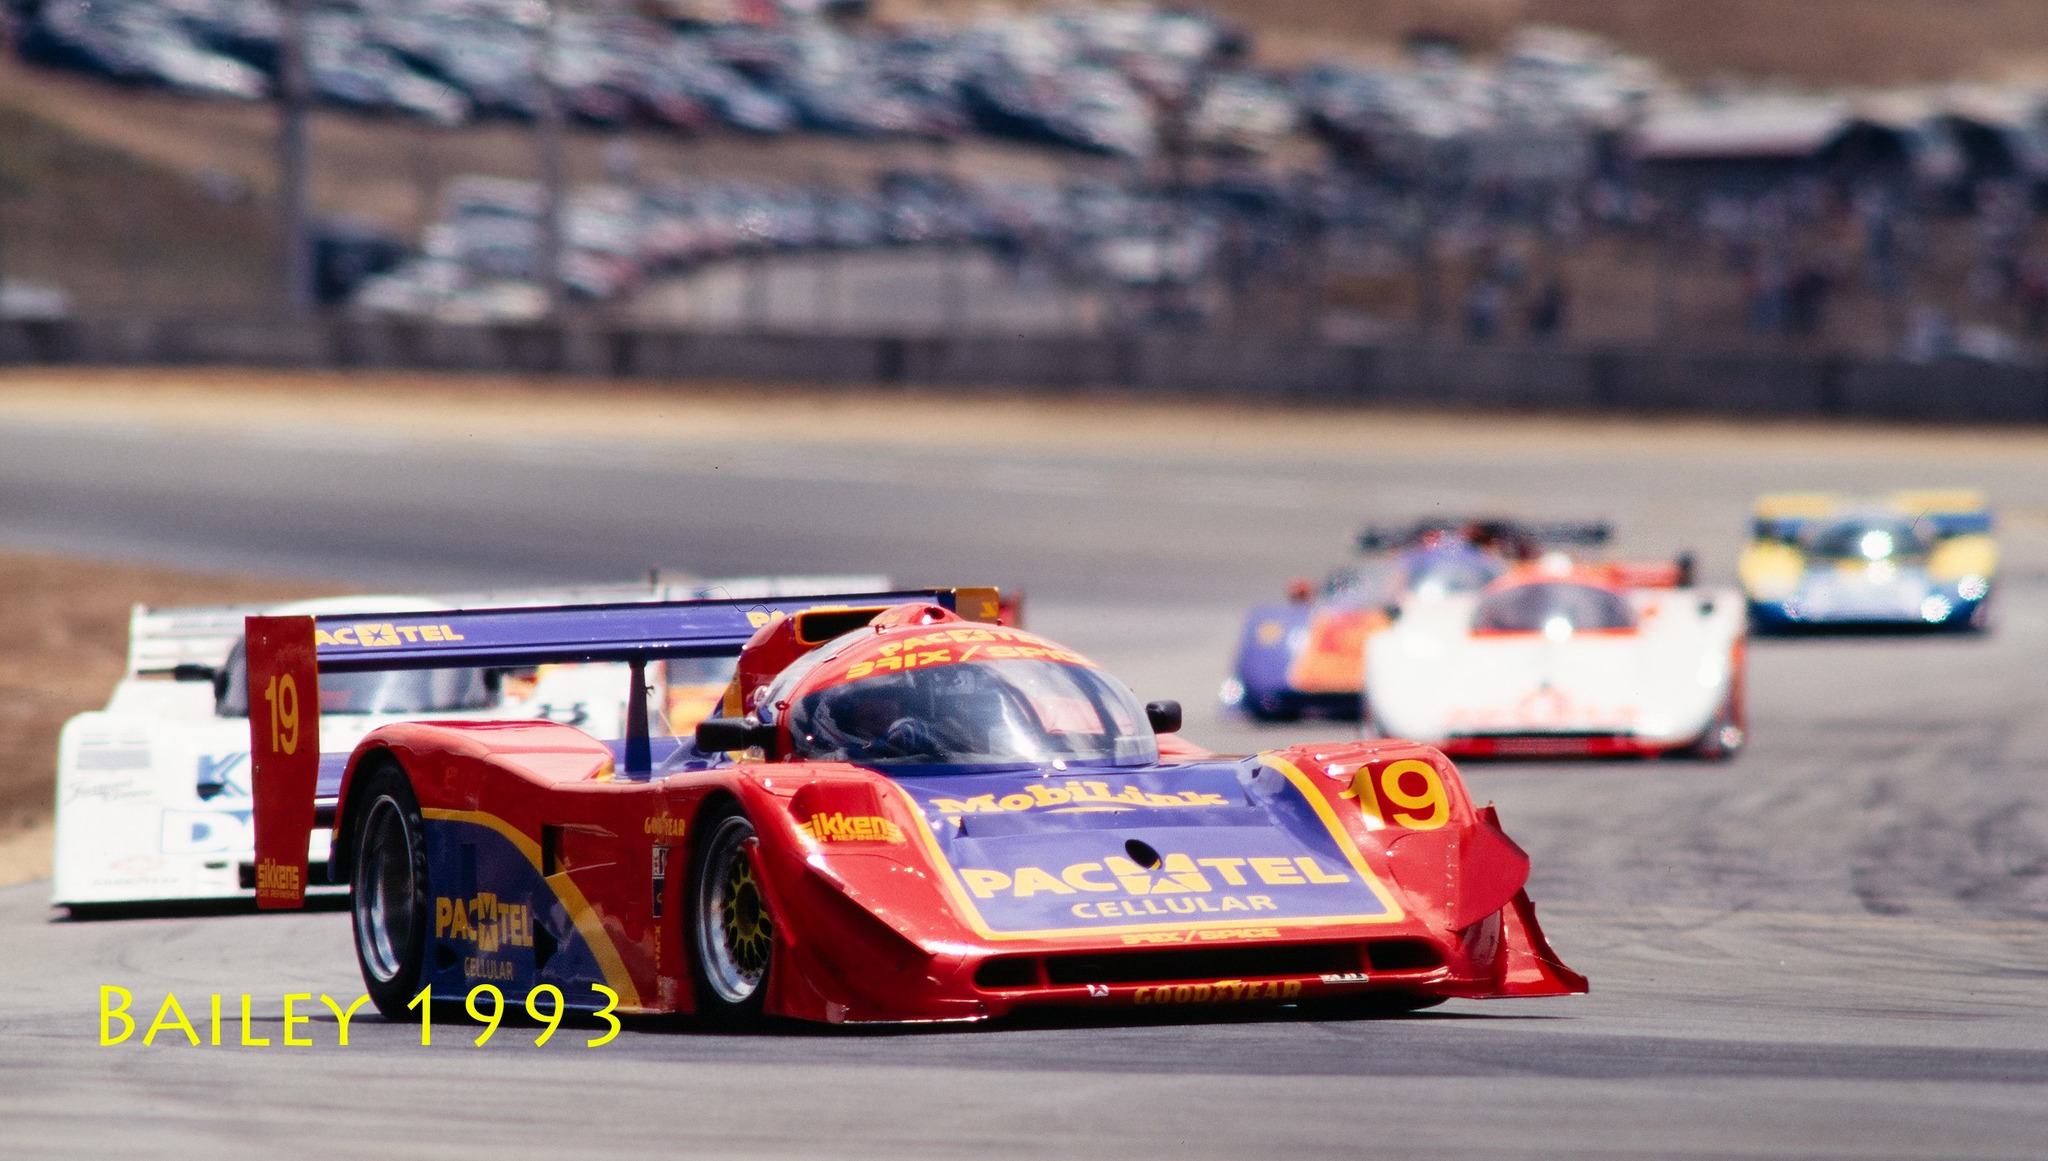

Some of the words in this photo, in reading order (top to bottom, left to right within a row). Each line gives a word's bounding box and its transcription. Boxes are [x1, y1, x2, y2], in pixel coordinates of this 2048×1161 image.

[265, 673, 299, 755] 19
[929, 780, 1230, 814] MobiLink
[1338, 759, 1450, 831] 19
[644, 811, 686, 837] GOODYEAR
[258, 858, 300, 890] sikkens
[1071, 895, 1278, 919] CELLULAR
[464, 956, 514, 981] CELLULAR
[1133, 980, 1302, 1005] GOODYEAR
